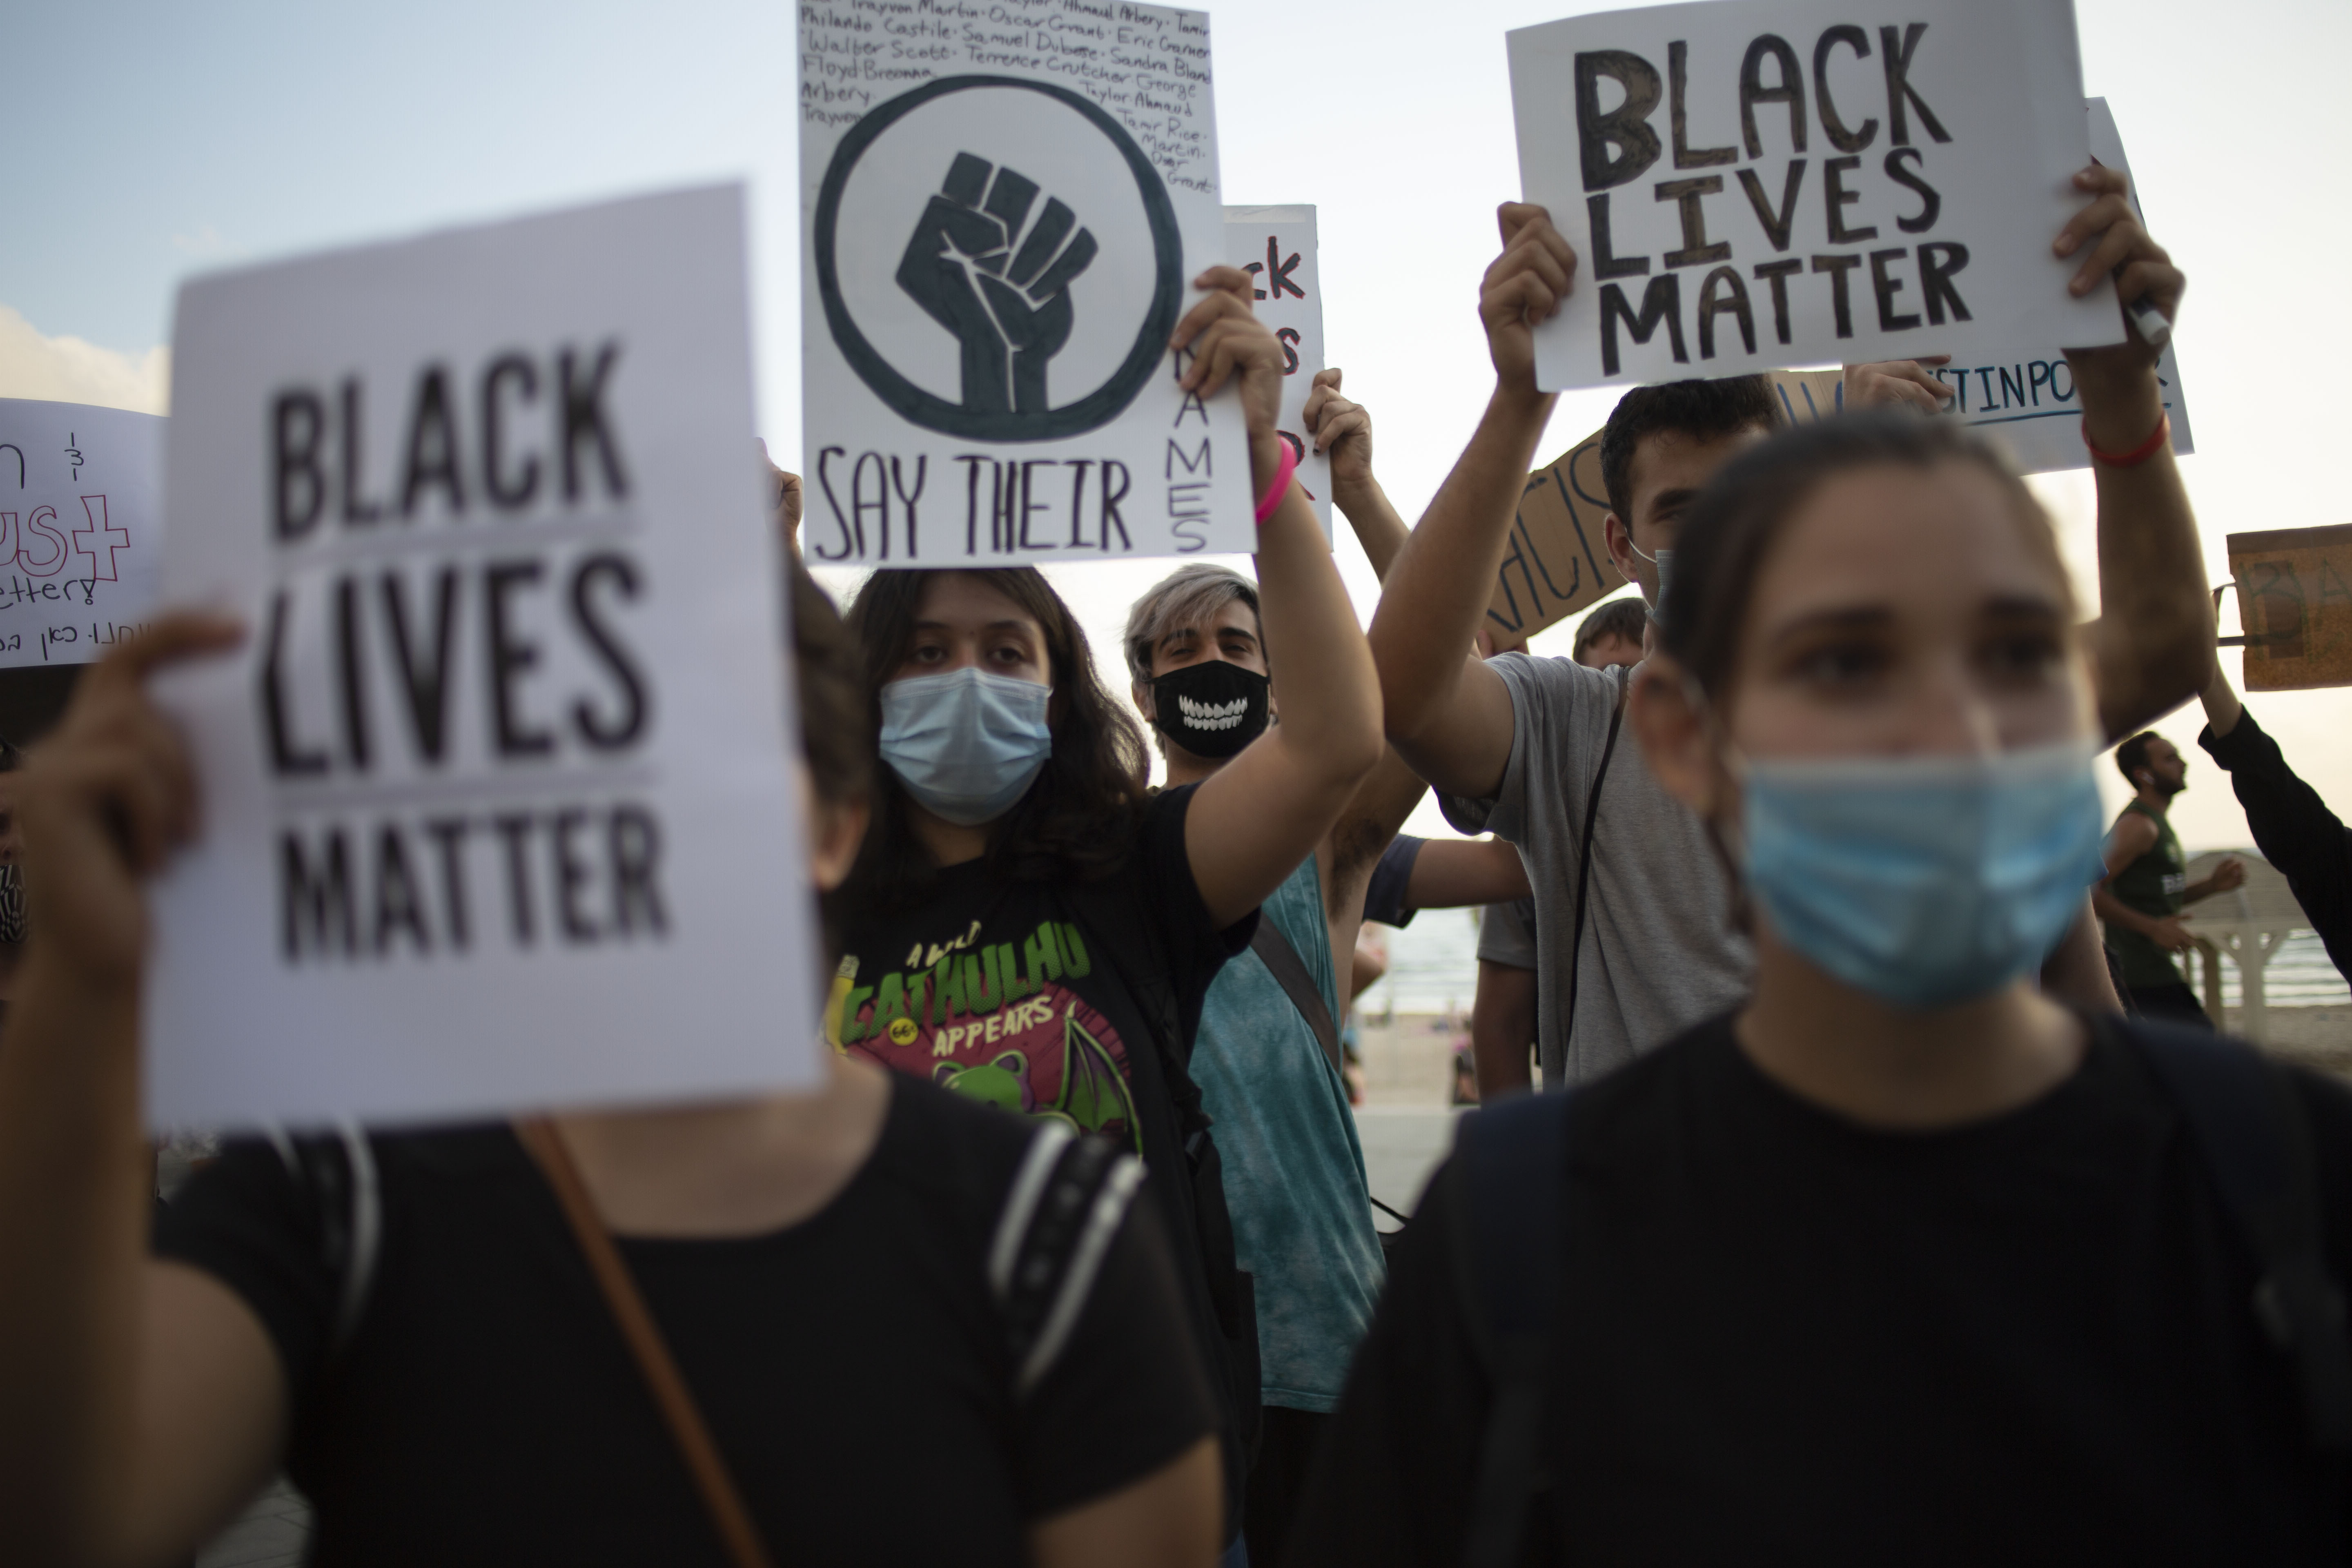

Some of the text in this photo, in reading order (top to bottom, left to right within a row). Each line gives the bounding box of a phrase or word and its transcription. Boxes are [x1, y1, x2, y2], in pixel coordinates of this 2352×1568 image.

[801, 6, 872, 32] Philando
[884, 17, 951, 40] Castile
[962, 22, 1029, 48] Samuel
[1111, 47, 1169, 73] Sandra
[1174, 56, 1211, 85] Bland
[918, 0, 978, 18] Martin
[989, 5, 1045, 28] Oscar
[1048, 14, 1105, 40] Grant
[1118, 26, 1154, 49] Eric
[1120, 4, 1163, 33] Arbery
[1174, 10, 1209, 37] Tamir
[802, 81, 870, 107] Arbery
[803, 54, 932, 83] Floyd Breonna
[809, 29, 1196, 101] Walter Scott Terrence Crutcher George
[1078, 80, 1192, 117] Taylor Ahmaud
[801, 103, 863, 128] Trayvon
[1116, 107, 1163, 131] Tamir
[1574, 22, 1953, 192] BLACK
[1587, 147, 1940, 281] LIVES
[1599, 241, 1973, 377] MATTER
[274, 339, 631, 543] BLACK
[815, 447, 1133, 560] SAY THEIR
[262, 553, 650, 777] LIVES
[278, 801, 672, 966] MATTER
[840, 920, 1091, 1045] CATHULHU
[906, 942, 923, 969] A
[933, 996, 1054, 1057] APPEARS
